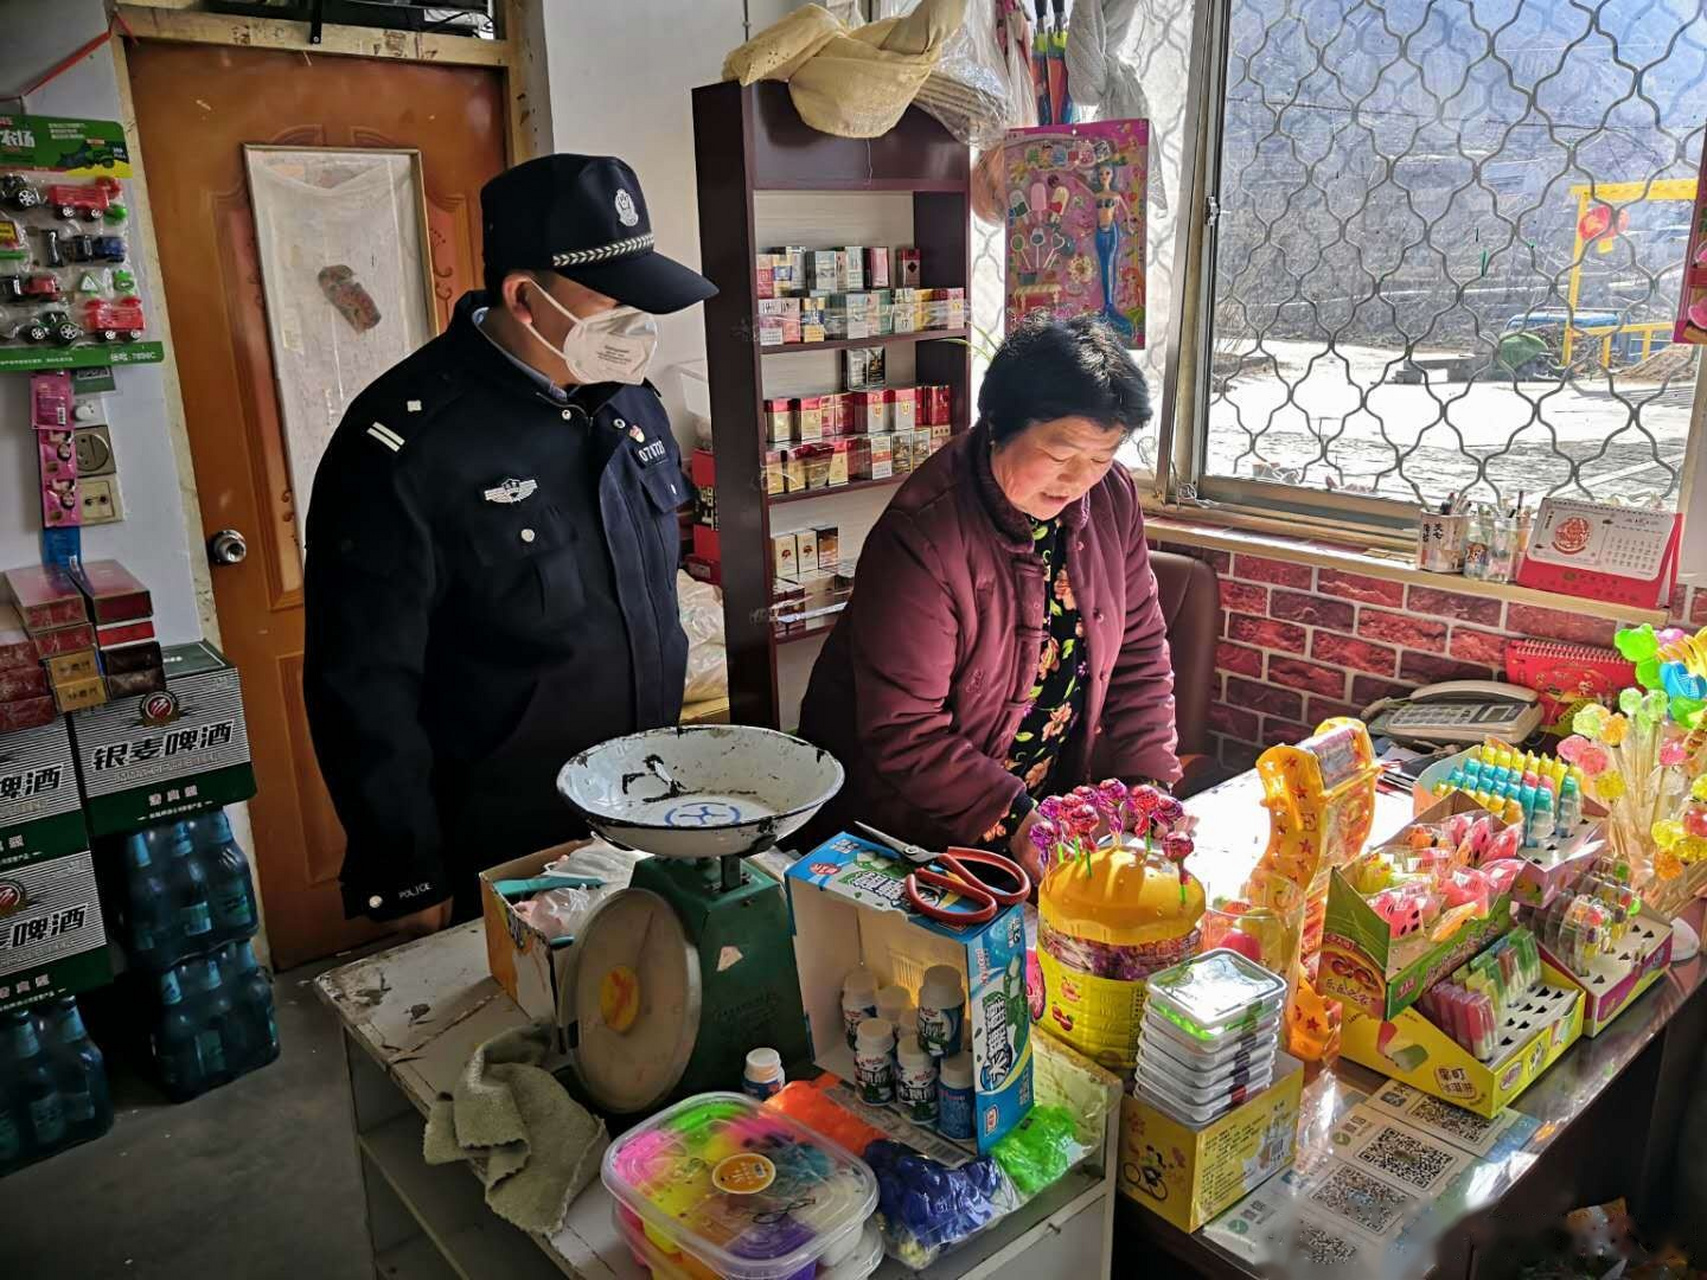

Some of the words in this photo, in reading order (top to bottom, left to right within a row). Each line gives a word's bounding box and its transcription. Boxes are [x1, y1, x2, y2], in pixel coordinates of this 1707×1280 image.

[93, 719, 234, 771] 银麦啤酒
[398, 882, 433, 899] POLICE
[0, 904, 87, 951] 啤酒
[984, 1000, 1012, 1083] 木糖醇
